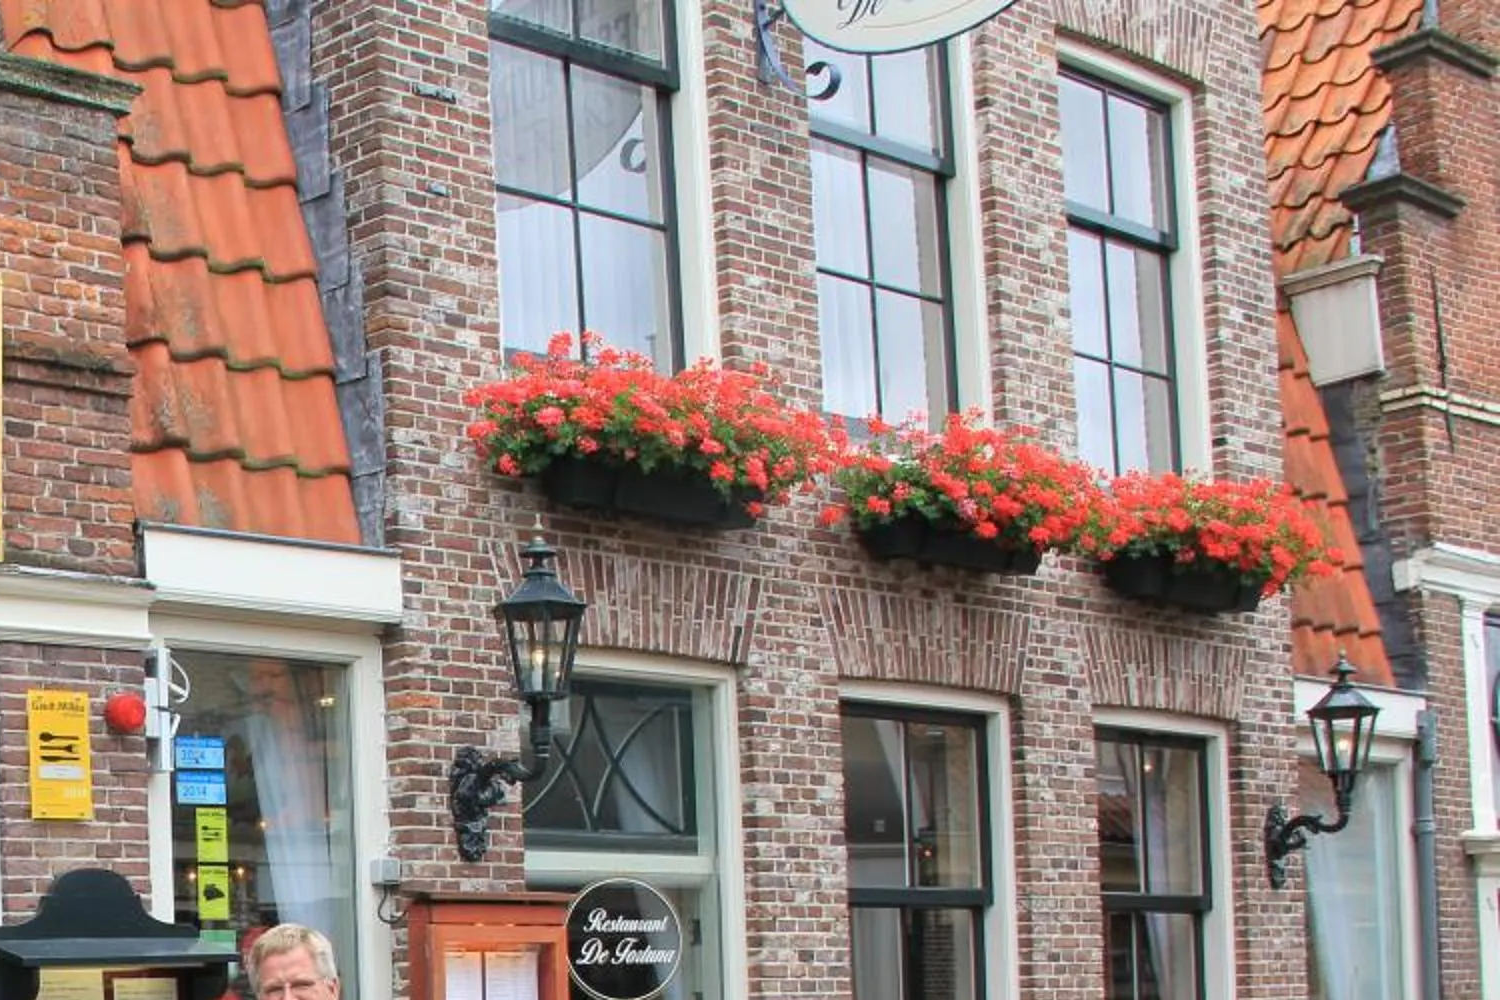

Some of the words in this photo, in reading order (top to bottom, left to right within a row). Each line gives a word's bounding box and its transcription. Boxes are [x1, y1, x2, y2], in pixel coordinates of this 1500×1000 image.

[583, 907, 669, 933] Restaurant
[575, 937, 609, 965] De
[611, 937, 676, 965] Fortuna
